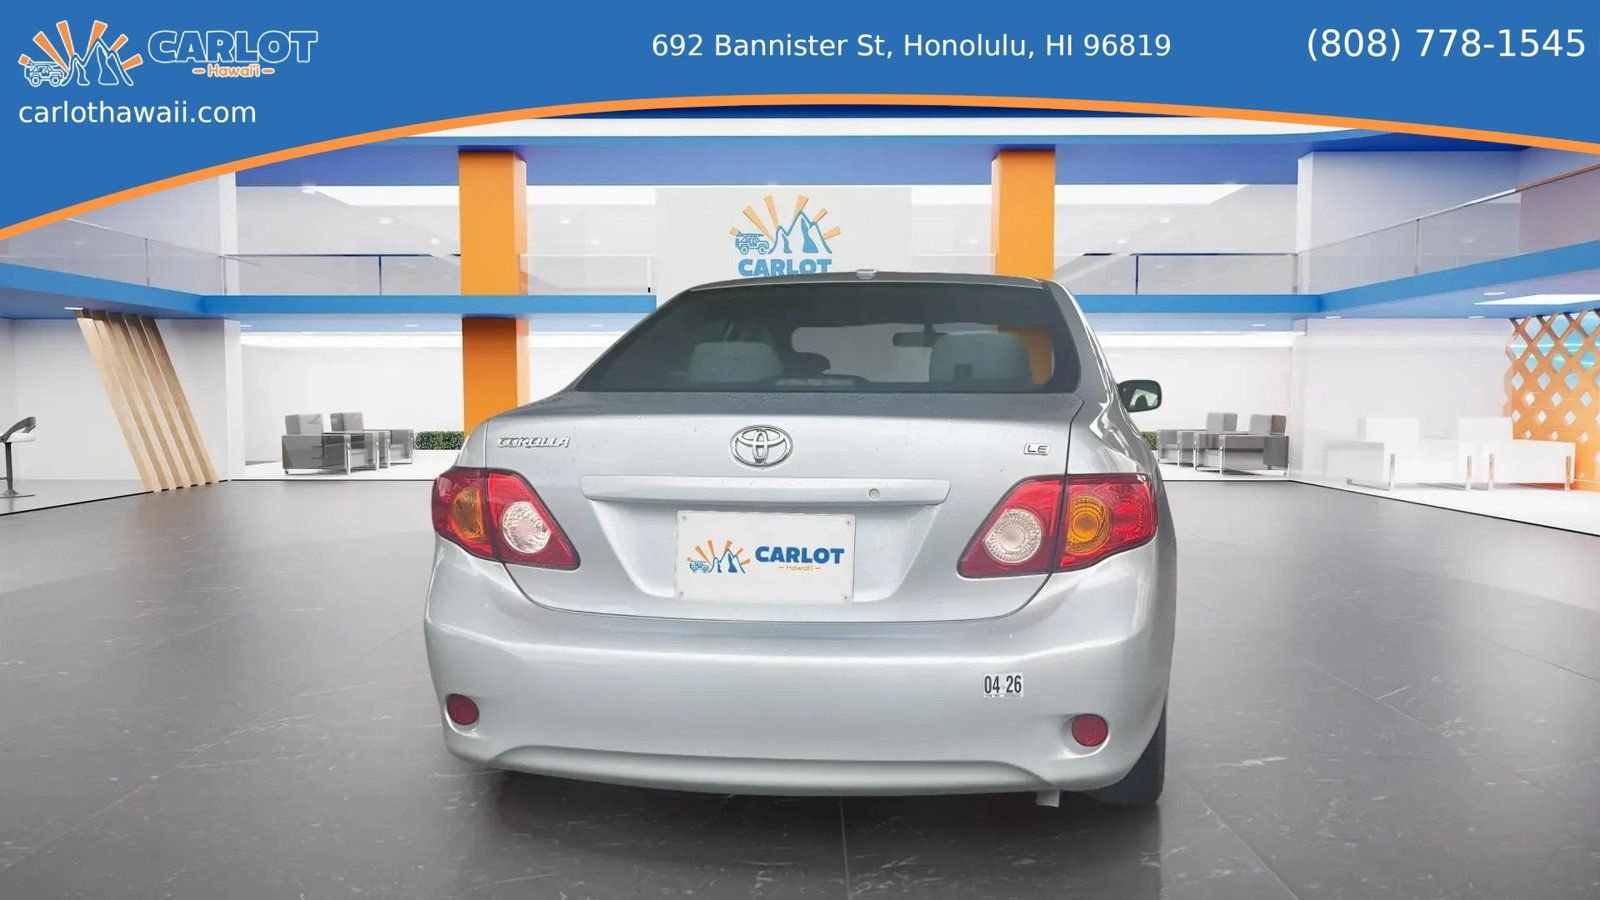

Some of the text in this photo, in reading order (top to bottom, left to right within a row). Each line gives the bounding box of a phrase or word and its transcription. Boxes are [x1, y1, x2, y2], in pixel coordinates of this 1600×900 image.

[738, 258, 832, 277] CARLOT
[497, 437, 570, 448] COROLLA
[1026, 443, 1049, 454] LE
[755, 546, 845, 564] CARLOT
[984, 675, 1022, 694] 04 26
